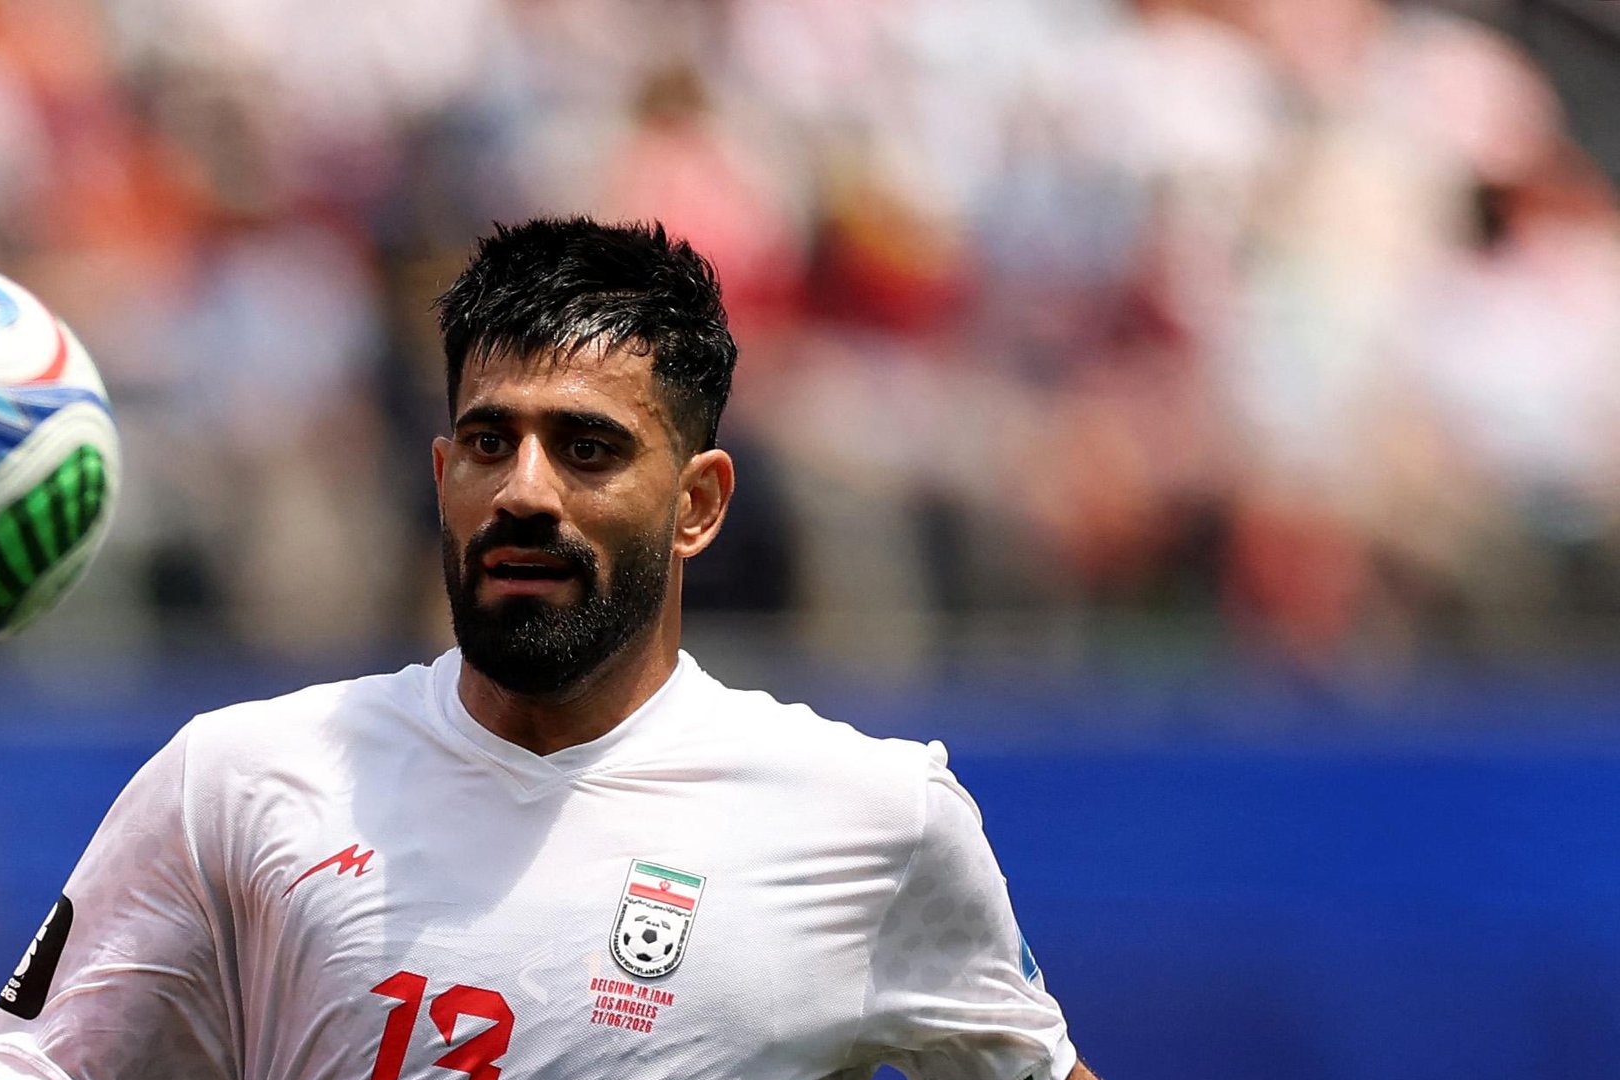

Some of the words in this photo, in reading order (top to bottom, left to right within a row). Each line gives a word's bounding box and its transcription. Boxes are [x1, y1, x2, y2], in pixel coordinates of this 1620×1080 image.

[595, 995, 615, 1010] LOS
[615, 998, 659, 1019] ANGELES
[590, 1010, 653, 1033] 21/06/2026
